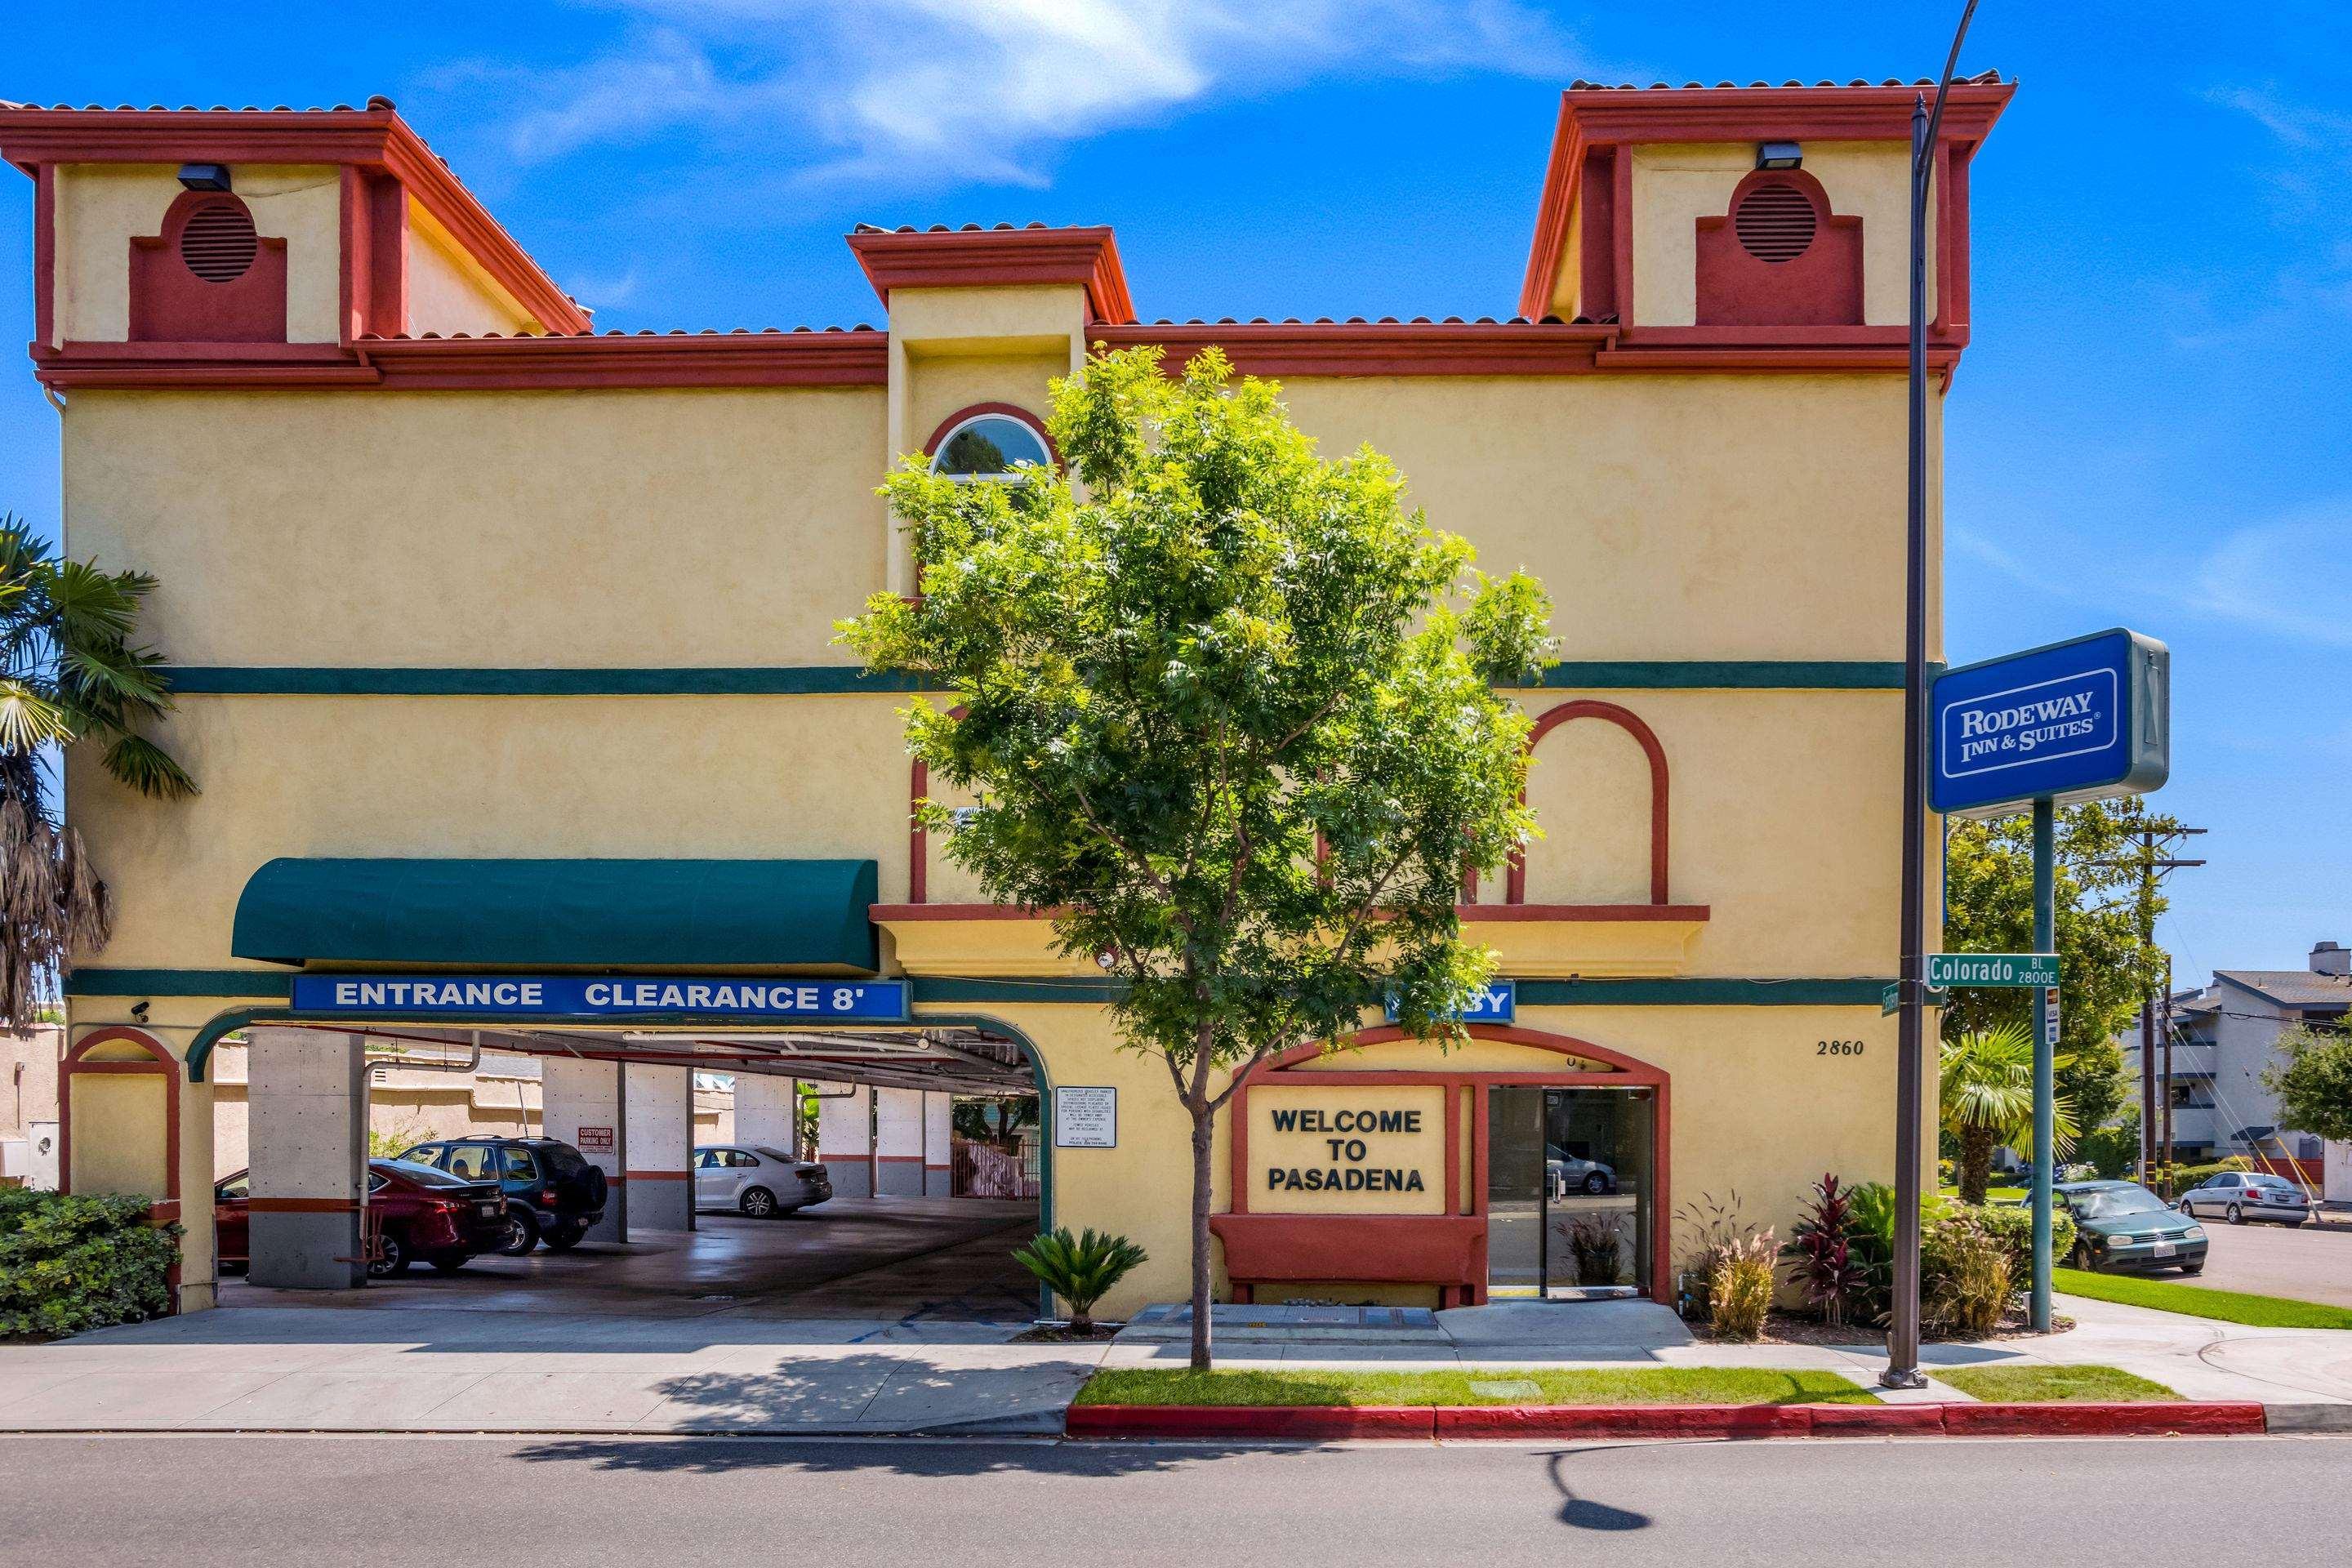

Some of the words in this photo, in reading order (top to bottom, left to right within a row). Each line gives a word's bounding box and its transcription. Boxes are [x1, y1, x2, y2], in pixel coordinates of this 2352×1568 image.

[1961, 691, 2094, 738] RODEWAY
[1961, 737, 1998, 763] INN
[2001, 734, 2016, 750] &
[2019, 718, 2094, 751] SUITES
[1930, 957, 2012, 981] Colorado
[2031, 958, 2043, 969] BL
[2018, 972, 2056, 983] 2800E
[336, 982, 543, 1005] ENTRANCE
[585, 983, 819, 1009] CLEARANCE
[832, 987, 864, 1011] 8'
[1816, 1040, 1864, 1055] 2860
[580, 1129, 612, 1137] CUSTOMER
[1272, 1110, 1422, 1134] WELCOME
[1327, 1139, 1367, 1162] TO
[1268, 1168, 1425, 1192] PASADENA
